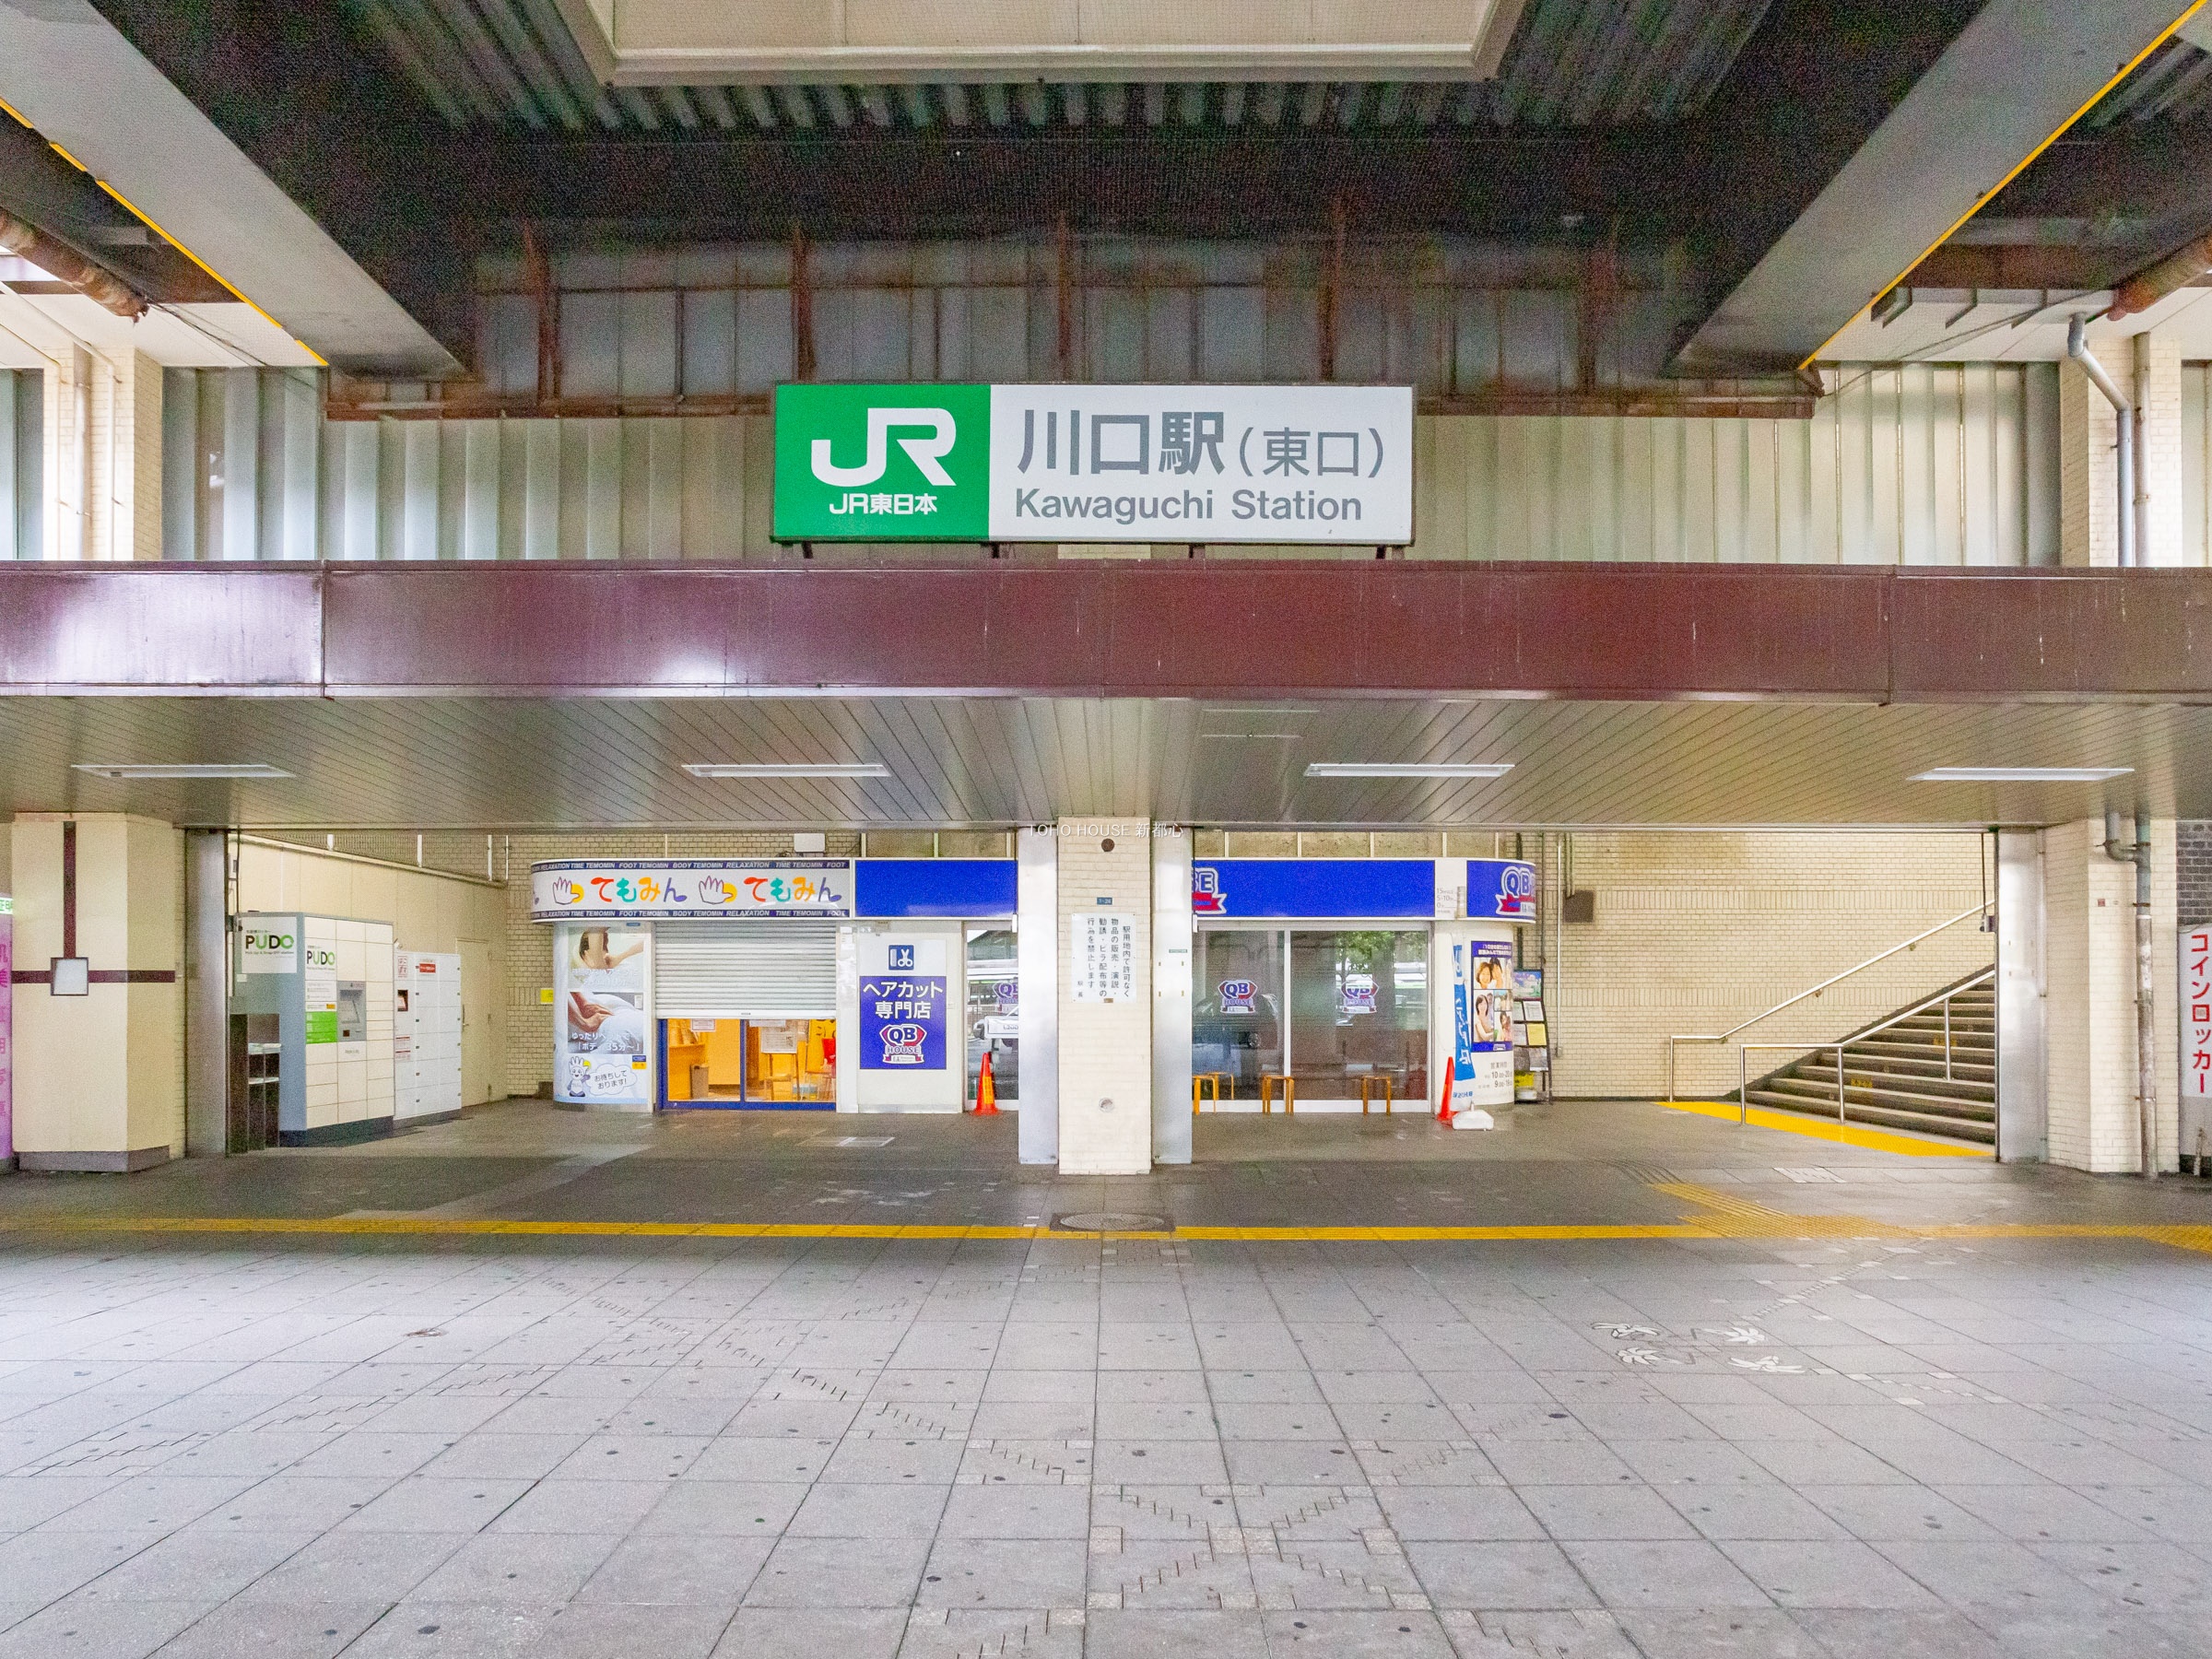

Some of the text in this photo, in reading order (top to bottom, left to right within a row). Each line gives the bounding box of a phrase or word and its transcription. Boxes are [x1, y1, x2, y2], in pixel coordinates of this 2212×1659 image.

[811, 407, 957, 487] JR
[830, 492, 937, 515] JR東日本
[1016, 488, 1361, 525] Kawaguchi Station
[590, 877, 688, 903] てもみん
[743, 877, 842, 902] てもみん
[245, 934, 295, 950] PUDO
[306, 949, 336, 966] PUDO
[1087, 917, 1095, 989] 行為を禁止します
[1122, 925, 1131, 997] 駅用地内で許可なく
[863, 981, 944, 999] ヘアカット
[1225, 982, 1250, 998] QB
[875, 1000, 932, 1019] 専門店
[2191, 934, 2212, 1094] コインロッカー
[887, 1026, 918, 1046] QB
[887, 1045, 920, 1054] HOUSE
[594, 1070, 627, 1083] お待ちして
